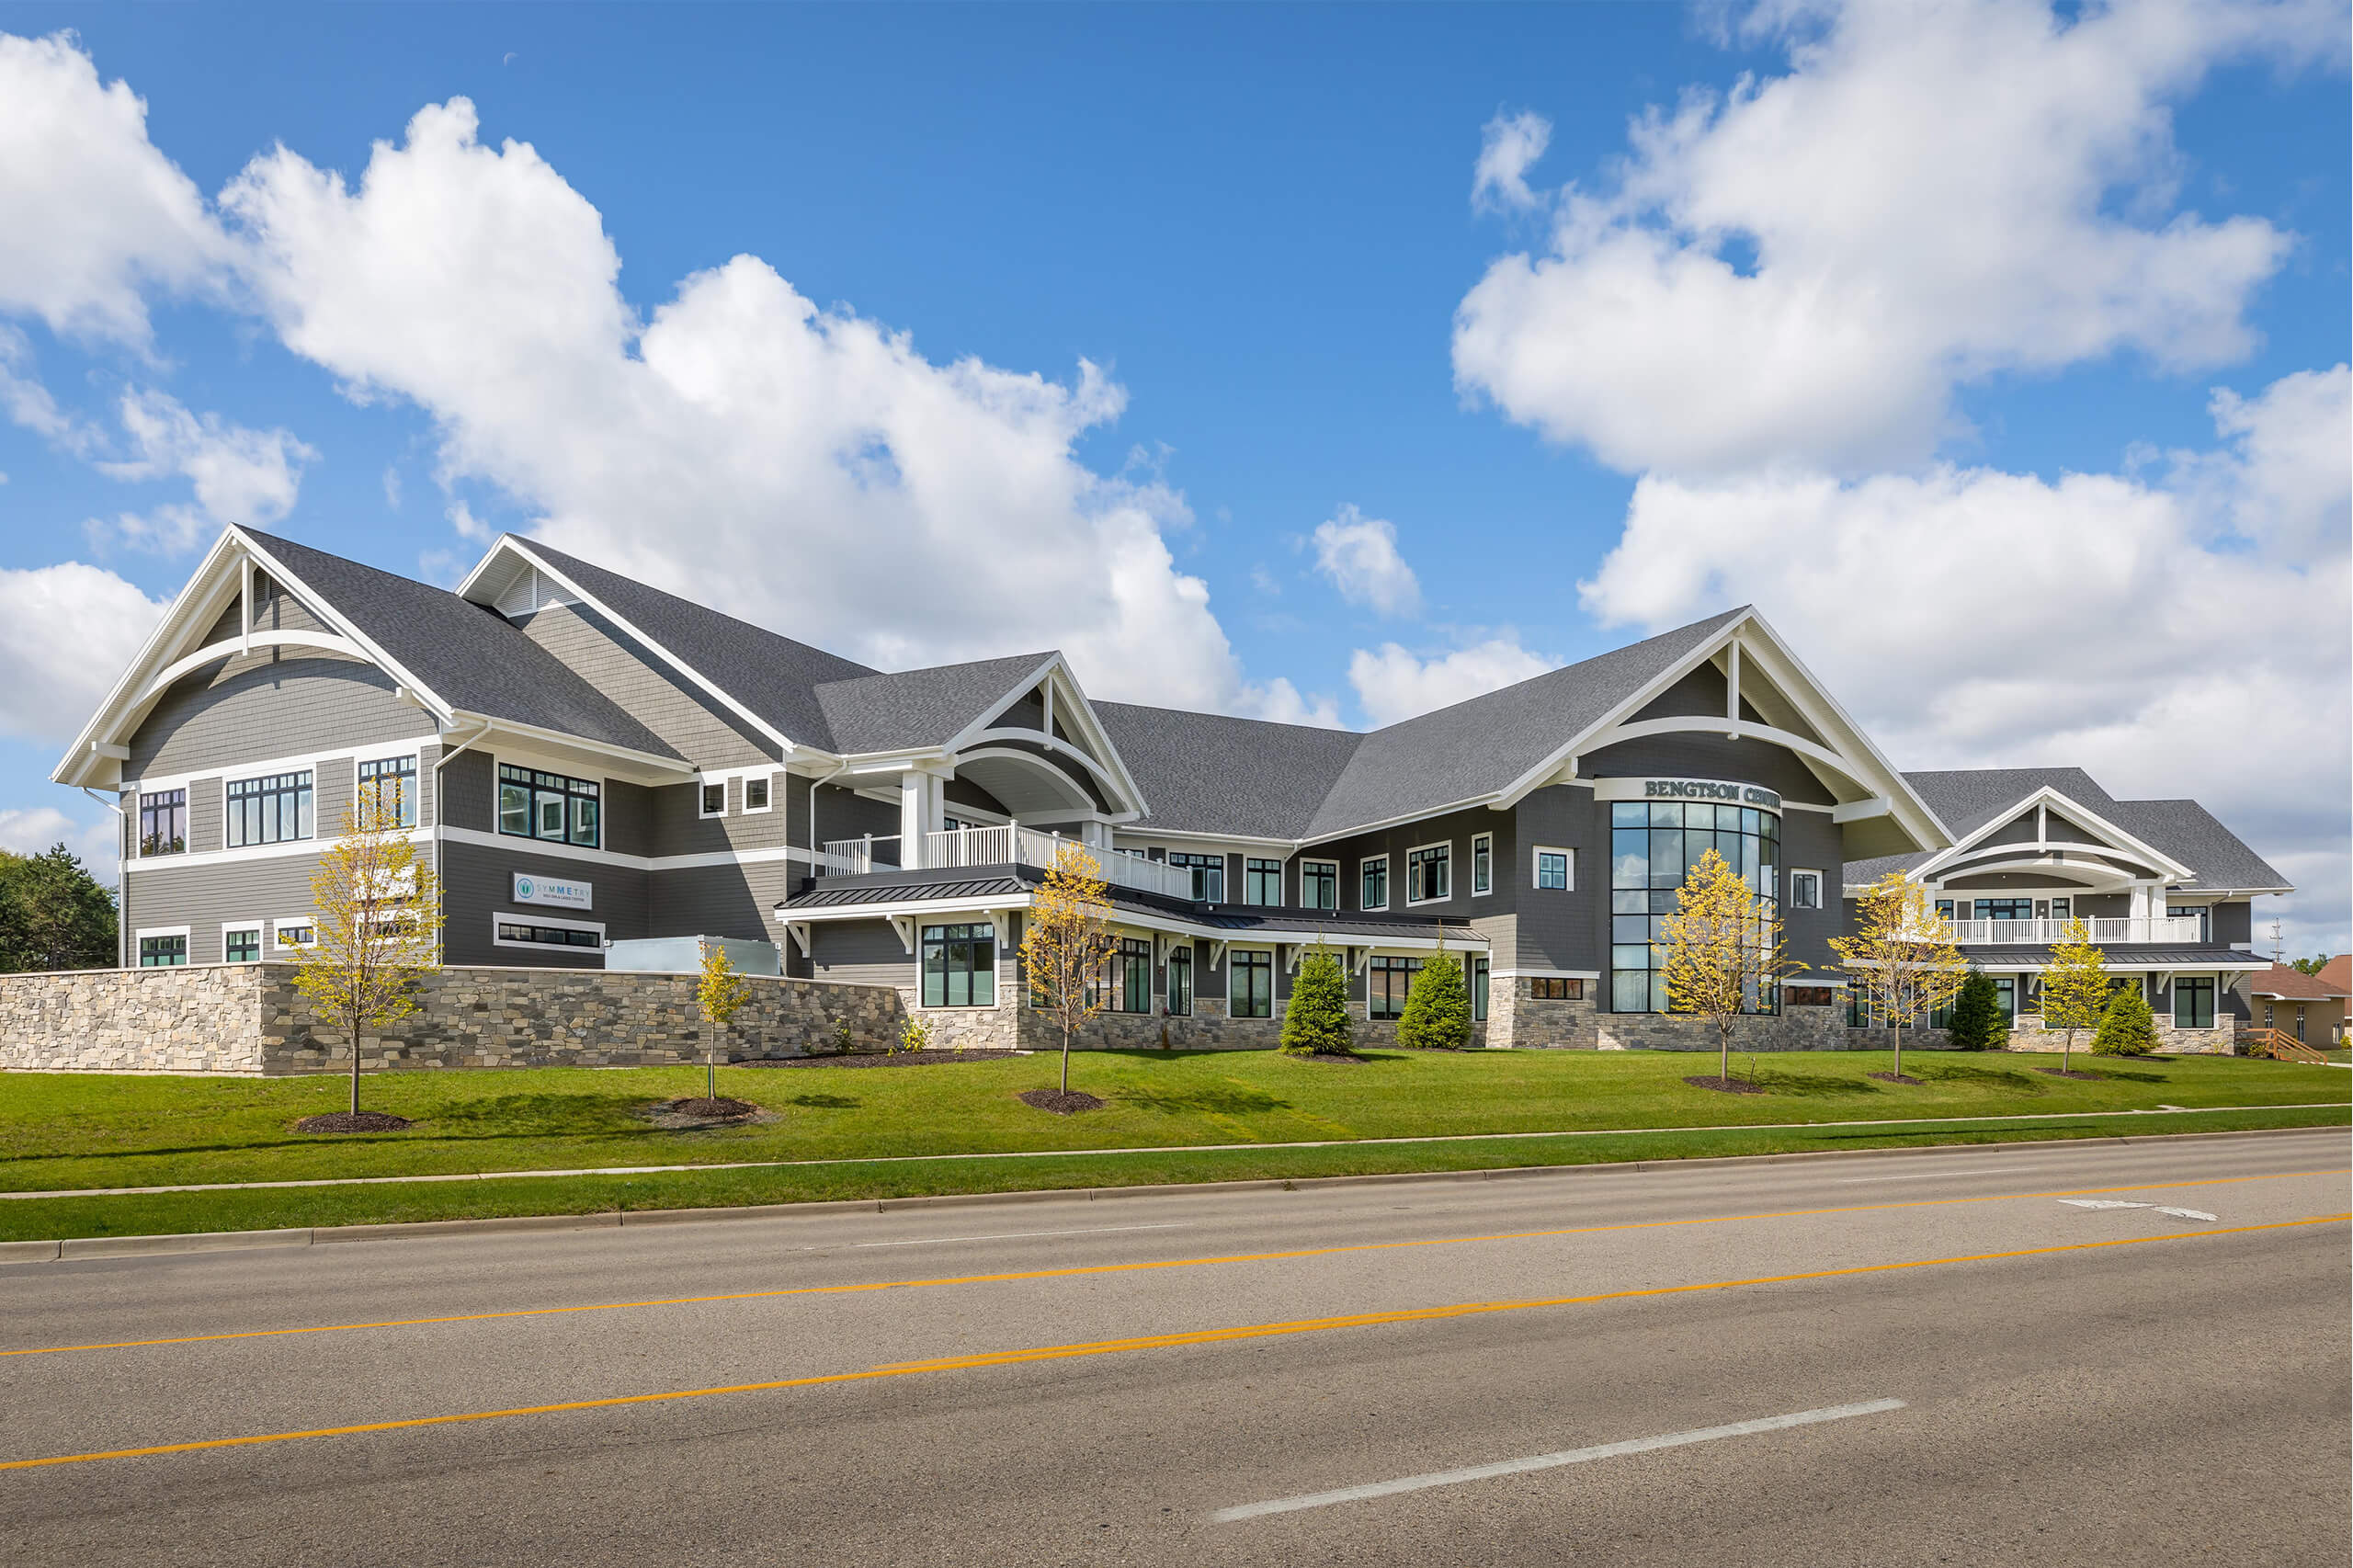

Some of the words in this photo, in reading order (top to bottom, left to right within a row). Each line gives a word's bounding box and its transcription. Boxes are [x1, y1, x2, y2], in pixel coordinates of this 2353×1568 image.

[1645, 780, 1740, 801] BENGTSON
[1744, 788, 1781, 809] CENT
[537, 883, 590, 897] SYMMETRY
